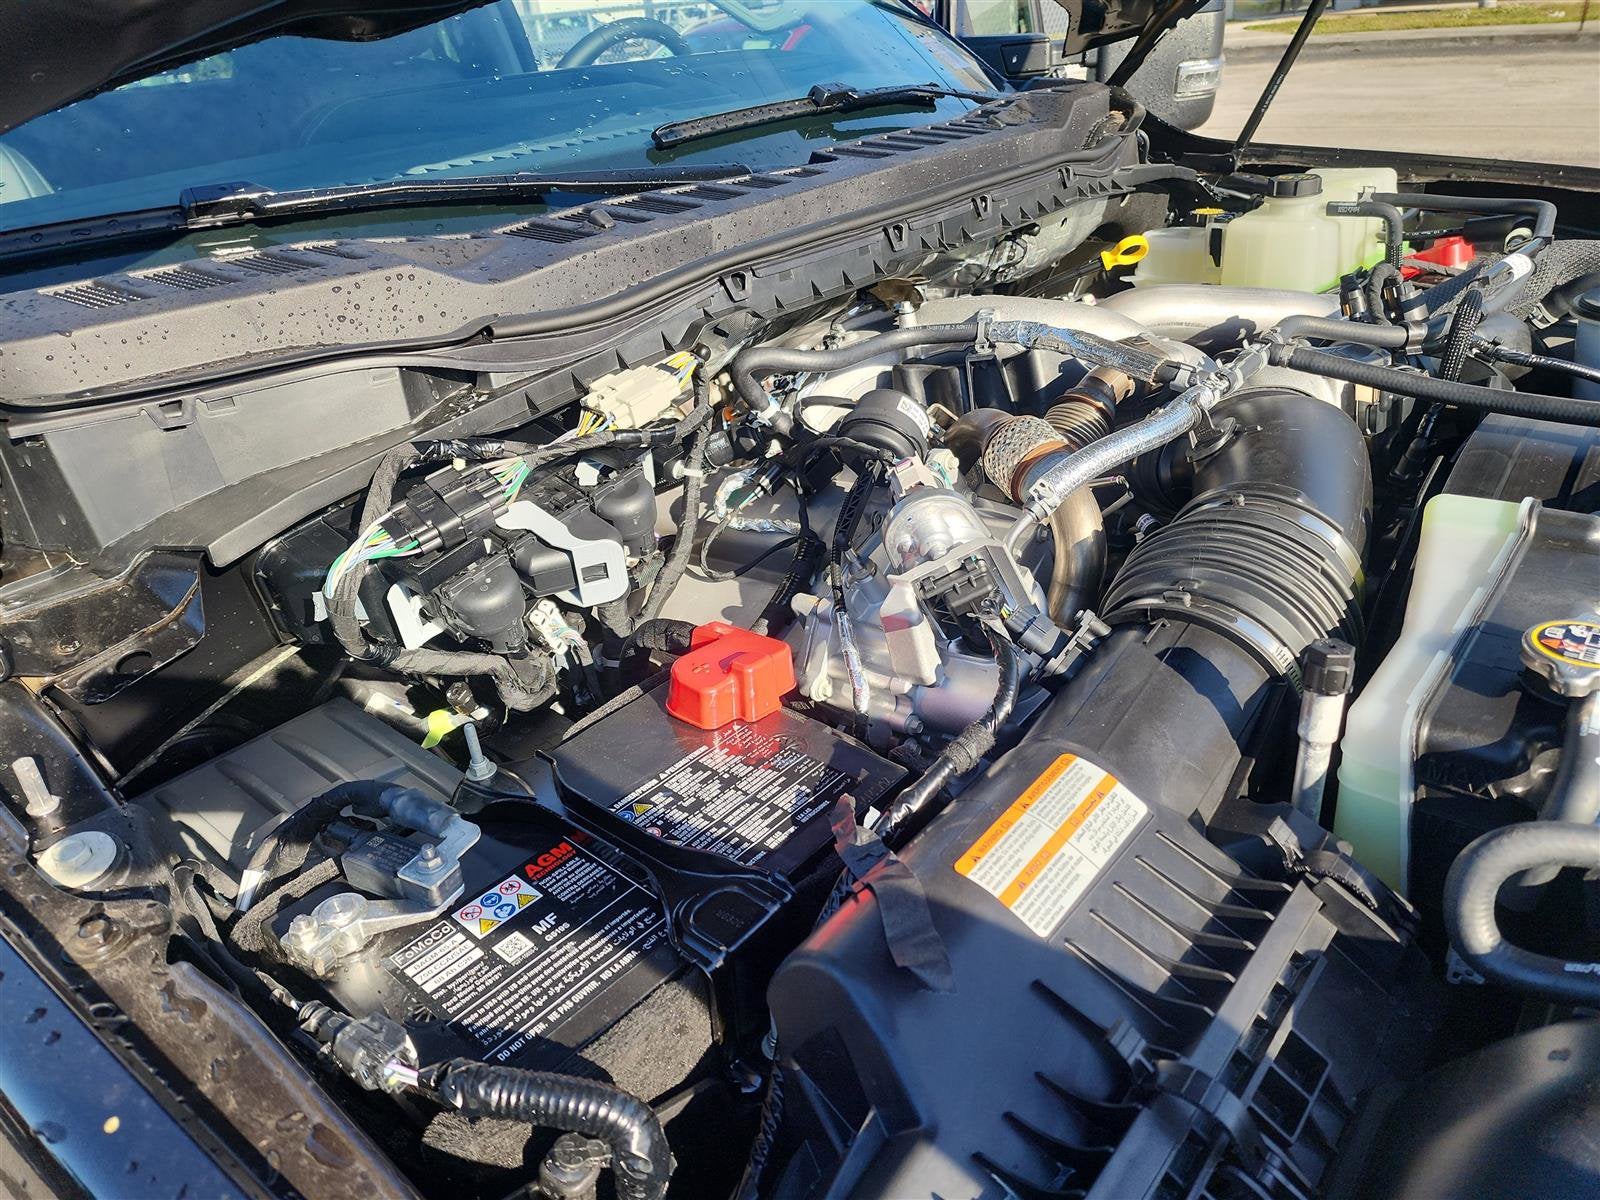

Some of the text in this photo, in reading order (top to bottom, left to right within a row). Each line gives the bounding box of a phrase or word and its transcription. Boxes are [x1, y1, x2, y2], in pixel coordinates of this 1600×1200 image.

[524, 842, 573, 878] AGM
[532, 849, 577, 880] TECHNOLOGY
[531, 912, 557, 935] MF
[394, 925, 451, 965] FoMoCo
[497, 1049, 511, 1060] DO
[508, 1037, 526, 1052] NOT
[523, 1020, 548, 1040] OPEN.
